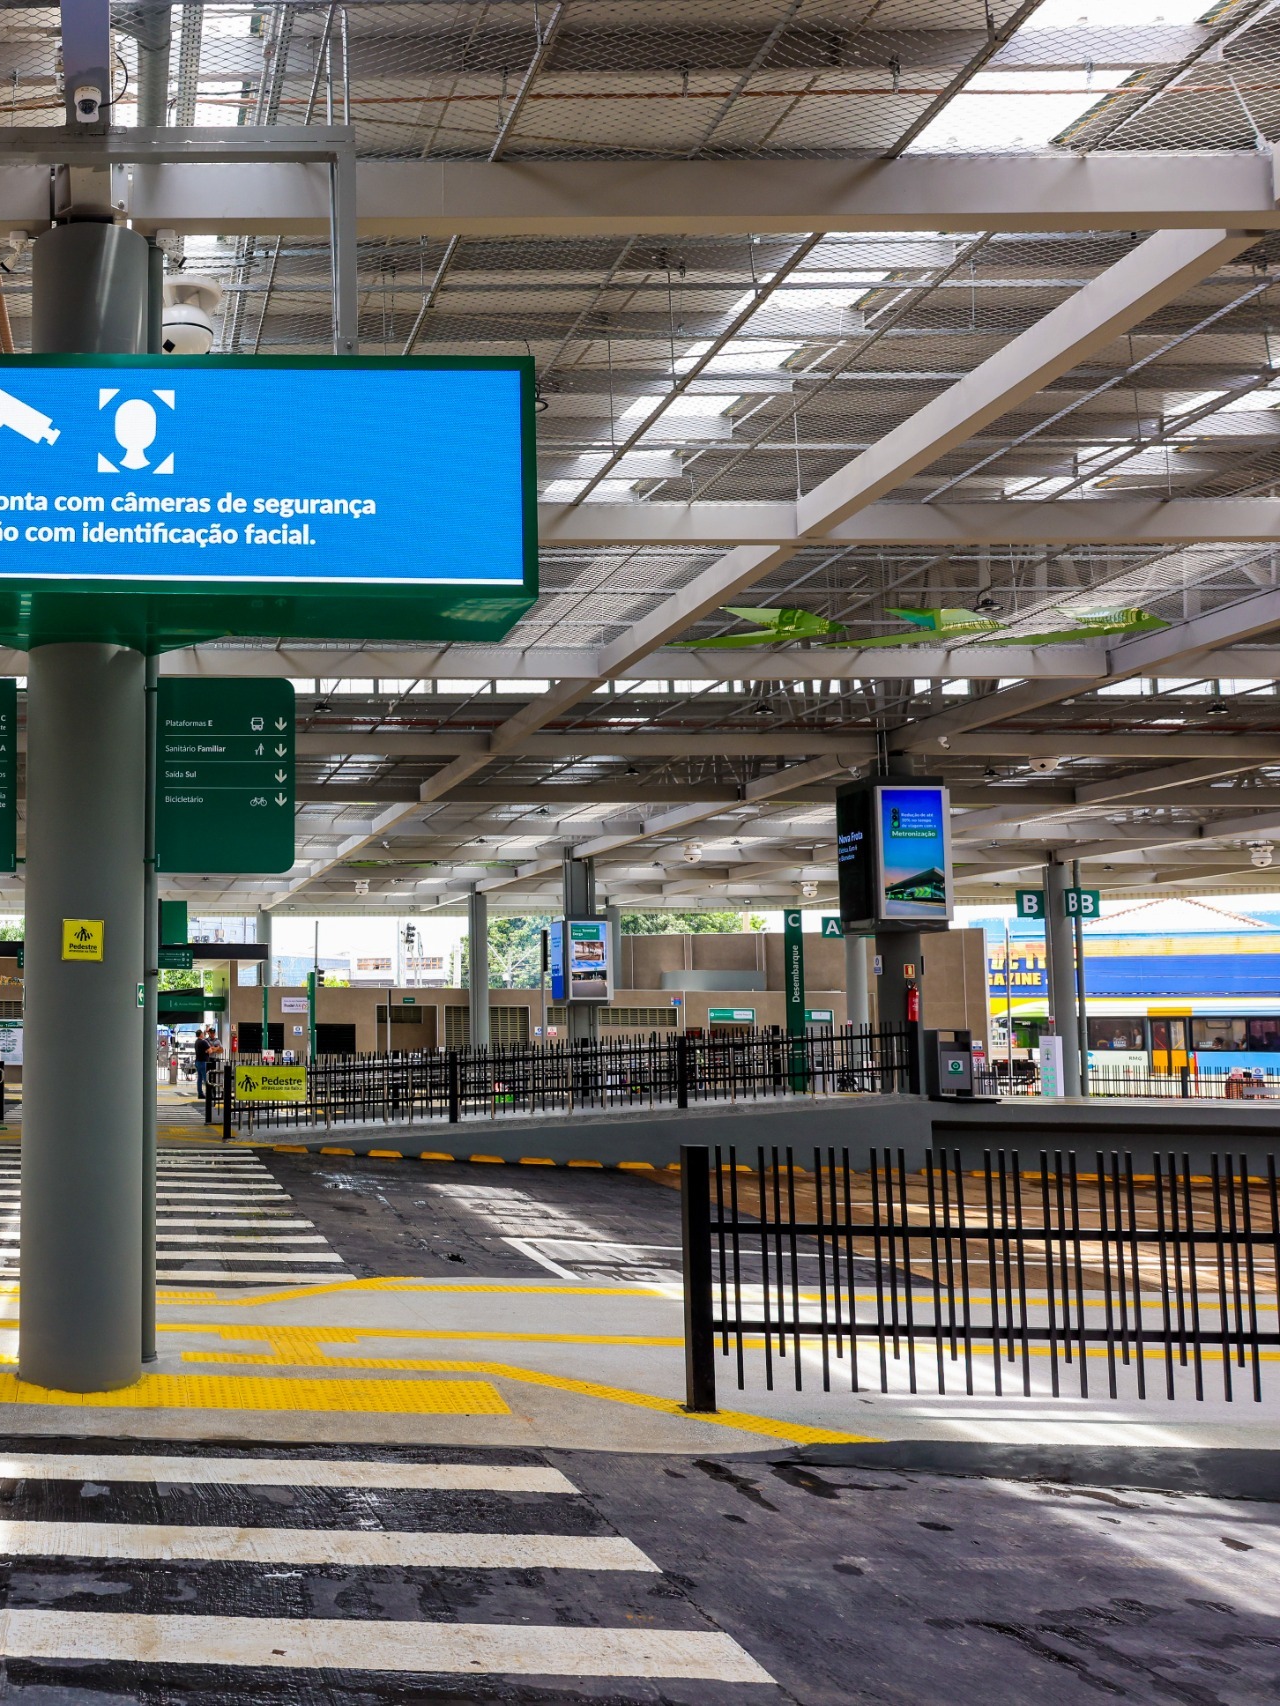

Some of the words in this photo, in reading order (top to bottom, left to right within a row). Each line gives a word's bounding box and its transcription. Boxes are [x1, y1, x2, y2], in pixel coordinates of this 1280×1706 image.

[54, 496, 105, 512] com
[111, 492, 211, 512] câmeras
[217, 493, 247, 513] de
[253, 498, 376, 518] segurança
[25, 525, 75, 542] com
[82, 522, 238, 548] identificação
[244, 523, 316, 545] facial.
[165, 744, 196, 752] Sanitário
[197, 744, 226, 752] Familiar
[838, 834, 851, 844] Nova
[851, 831, 863, 842] Frota
[891, 830, 936, 838] Metronização
[1022, 894, 1039, 914] B
[1068, 892, 1078, 912] B
[1081, 894, 1094, 914] B
[788, 913, 800, 927] C
[825, 919, 840, 935] A
[791, 945, 800, 1003] Desembarque
[261, 1076, 303, 1086] Pedestre
